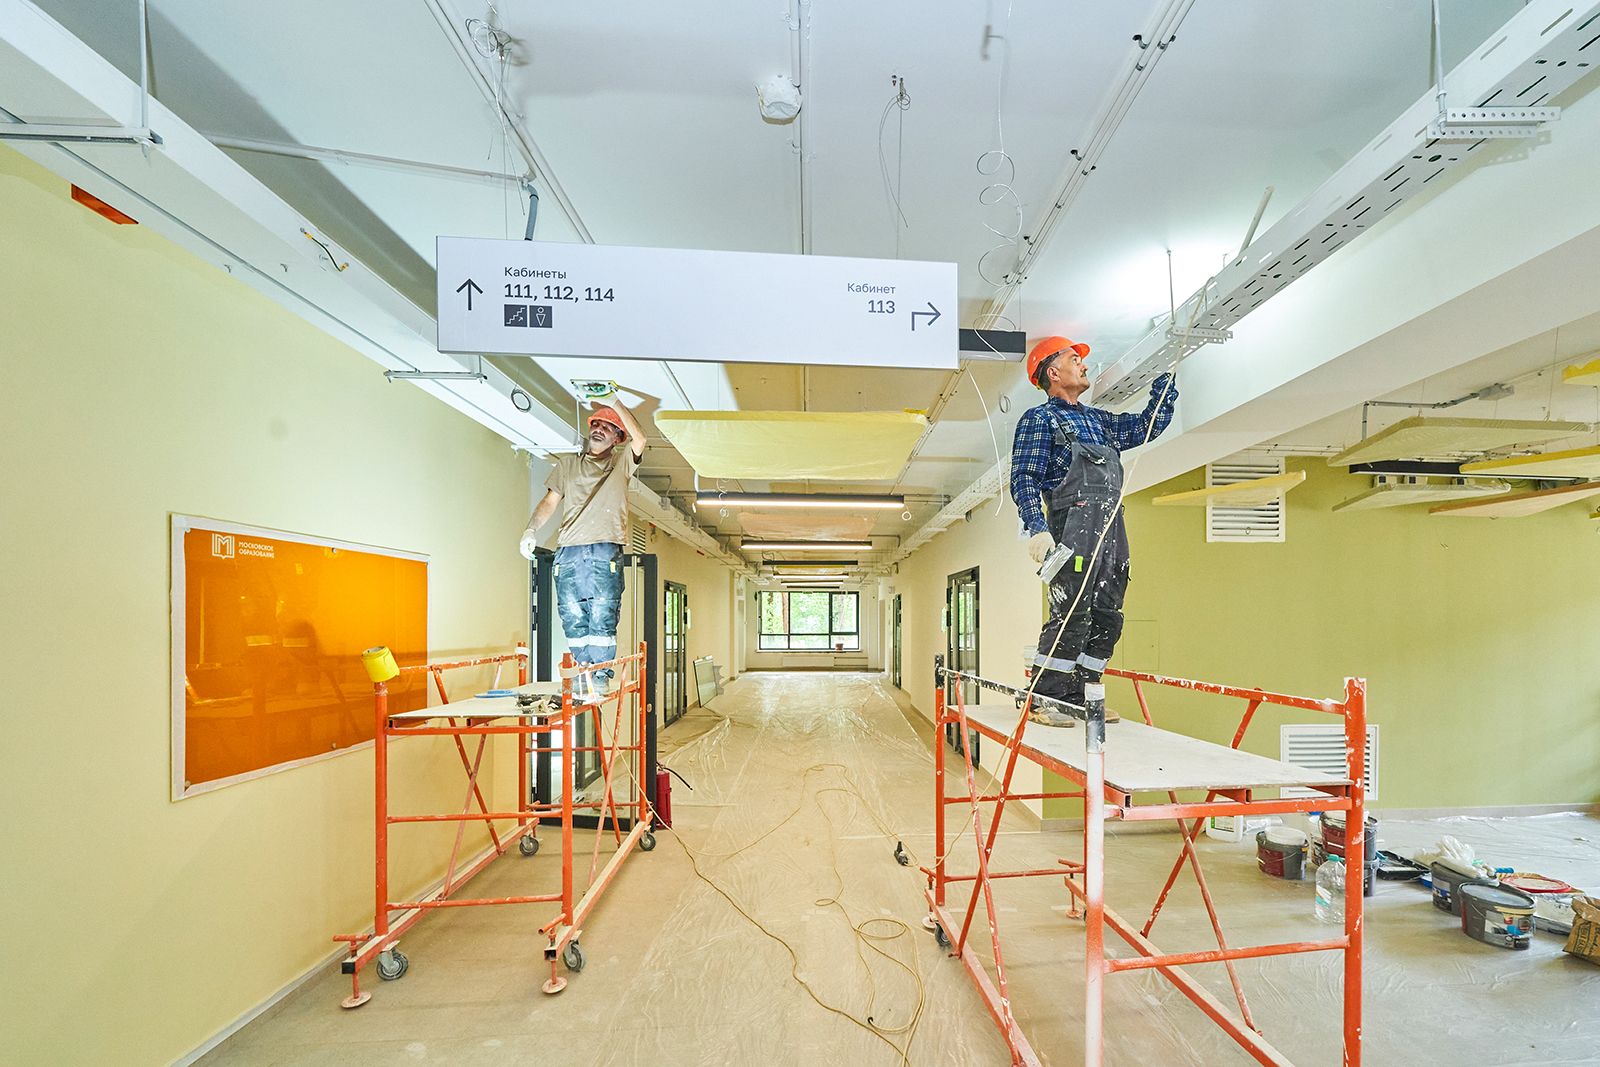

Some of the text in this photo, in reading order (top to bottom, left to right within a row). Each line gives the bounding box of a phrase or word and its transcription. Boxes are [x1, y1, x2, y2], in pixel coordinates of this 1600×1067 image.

[504, 266, 567, 279] Кабинеты
[504, 283, 615, 303] 111, 112, 114
[847, 282, 896, 294] Кабинет
[868, 299, 895, 314] 113
[238, 541, 274, 551] МОСКОВСКОЕ
[238, 548, 275, 559] ОБРАЗОВАНИЕ
